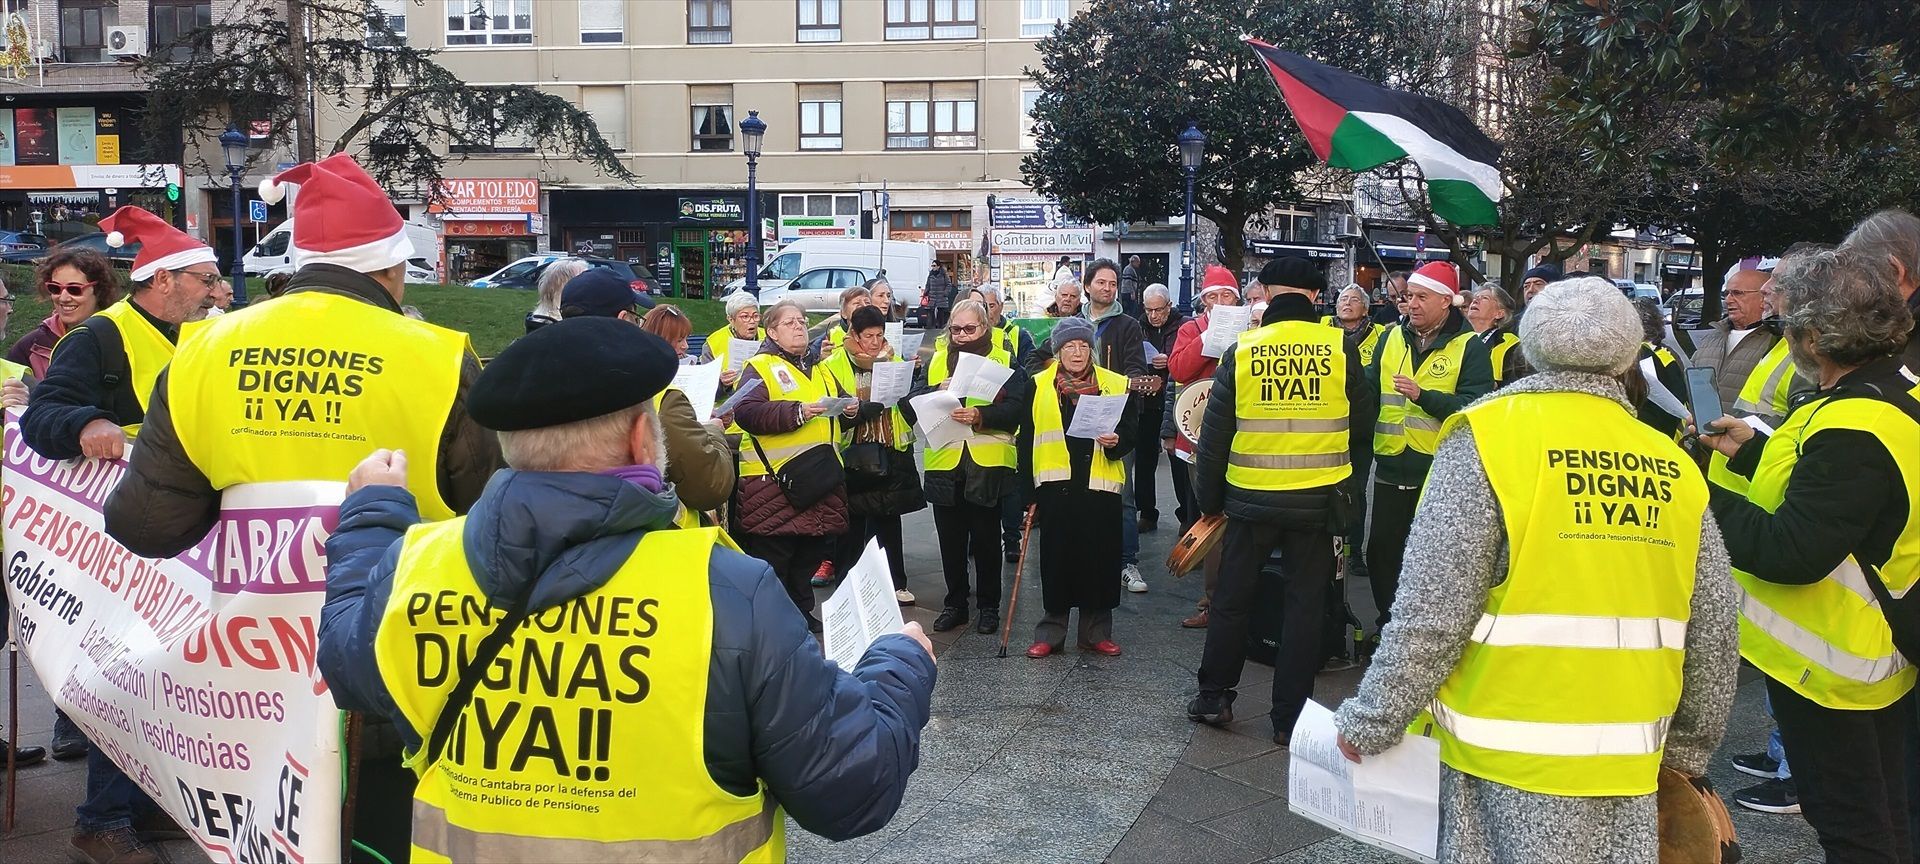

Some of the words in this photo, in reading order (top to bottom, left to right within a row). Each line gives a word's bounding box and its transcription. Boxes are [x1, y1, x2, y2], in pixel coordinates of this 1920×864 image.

[477, 181, 536, 198] TOLEDO
[695, 204, 740, 212] DIS.FRUTA
[959, 240, 972, 248] FE
[993, 233, 1055, 246] Cantabria
[229, 347, 384, 375] PENSIONES
[1251, 344, 1332, 358] PENSIONES
[1251, 358, 1331, 377] DIGNAS
[238, 369, 364, 397] DIGNAS
[1261, 378, 1320, 401] ¡¡YA!!
[245, 397, 263, 420] ¡¡
[275, 399, 315, 422] YA
[325, 401, 342, 424] !!
[331, 433, 366, 442] Cantabria
[1548, 449, 1681, 480] PENSIONES
[1566, 472, 1672, 504] DIGNAS
[1574, 501, 1593, 524] ¡¡
[1601, 502, 1641, 527] YA
[1646, 505, 1660, 529] !!
[8, 495, 133, 593] PENSIONES
[1559, 532, 1606, 541] Coordinadora
[8, 550, 84, 626] Gobierne
[407, 590, 659, 638] PENONES
[414, 632, 651, 704] DIGNAS
[162, 671, 285, 723] Pensiones
[140, 718, 251, 771] residencias
[480, 777, 531, 793] Cantabra
[535, 784, 554, 794] por
[558, 782, 567, 794] la
[570, 785, 615, 798] defensa
[618, 787, 636, 798] del
[274, 764, 303, 848] SE
[481, 791, 522, 807] Publico
[525, 797, 540, 808] de
[544, 798, 600, 814] Pensiones
